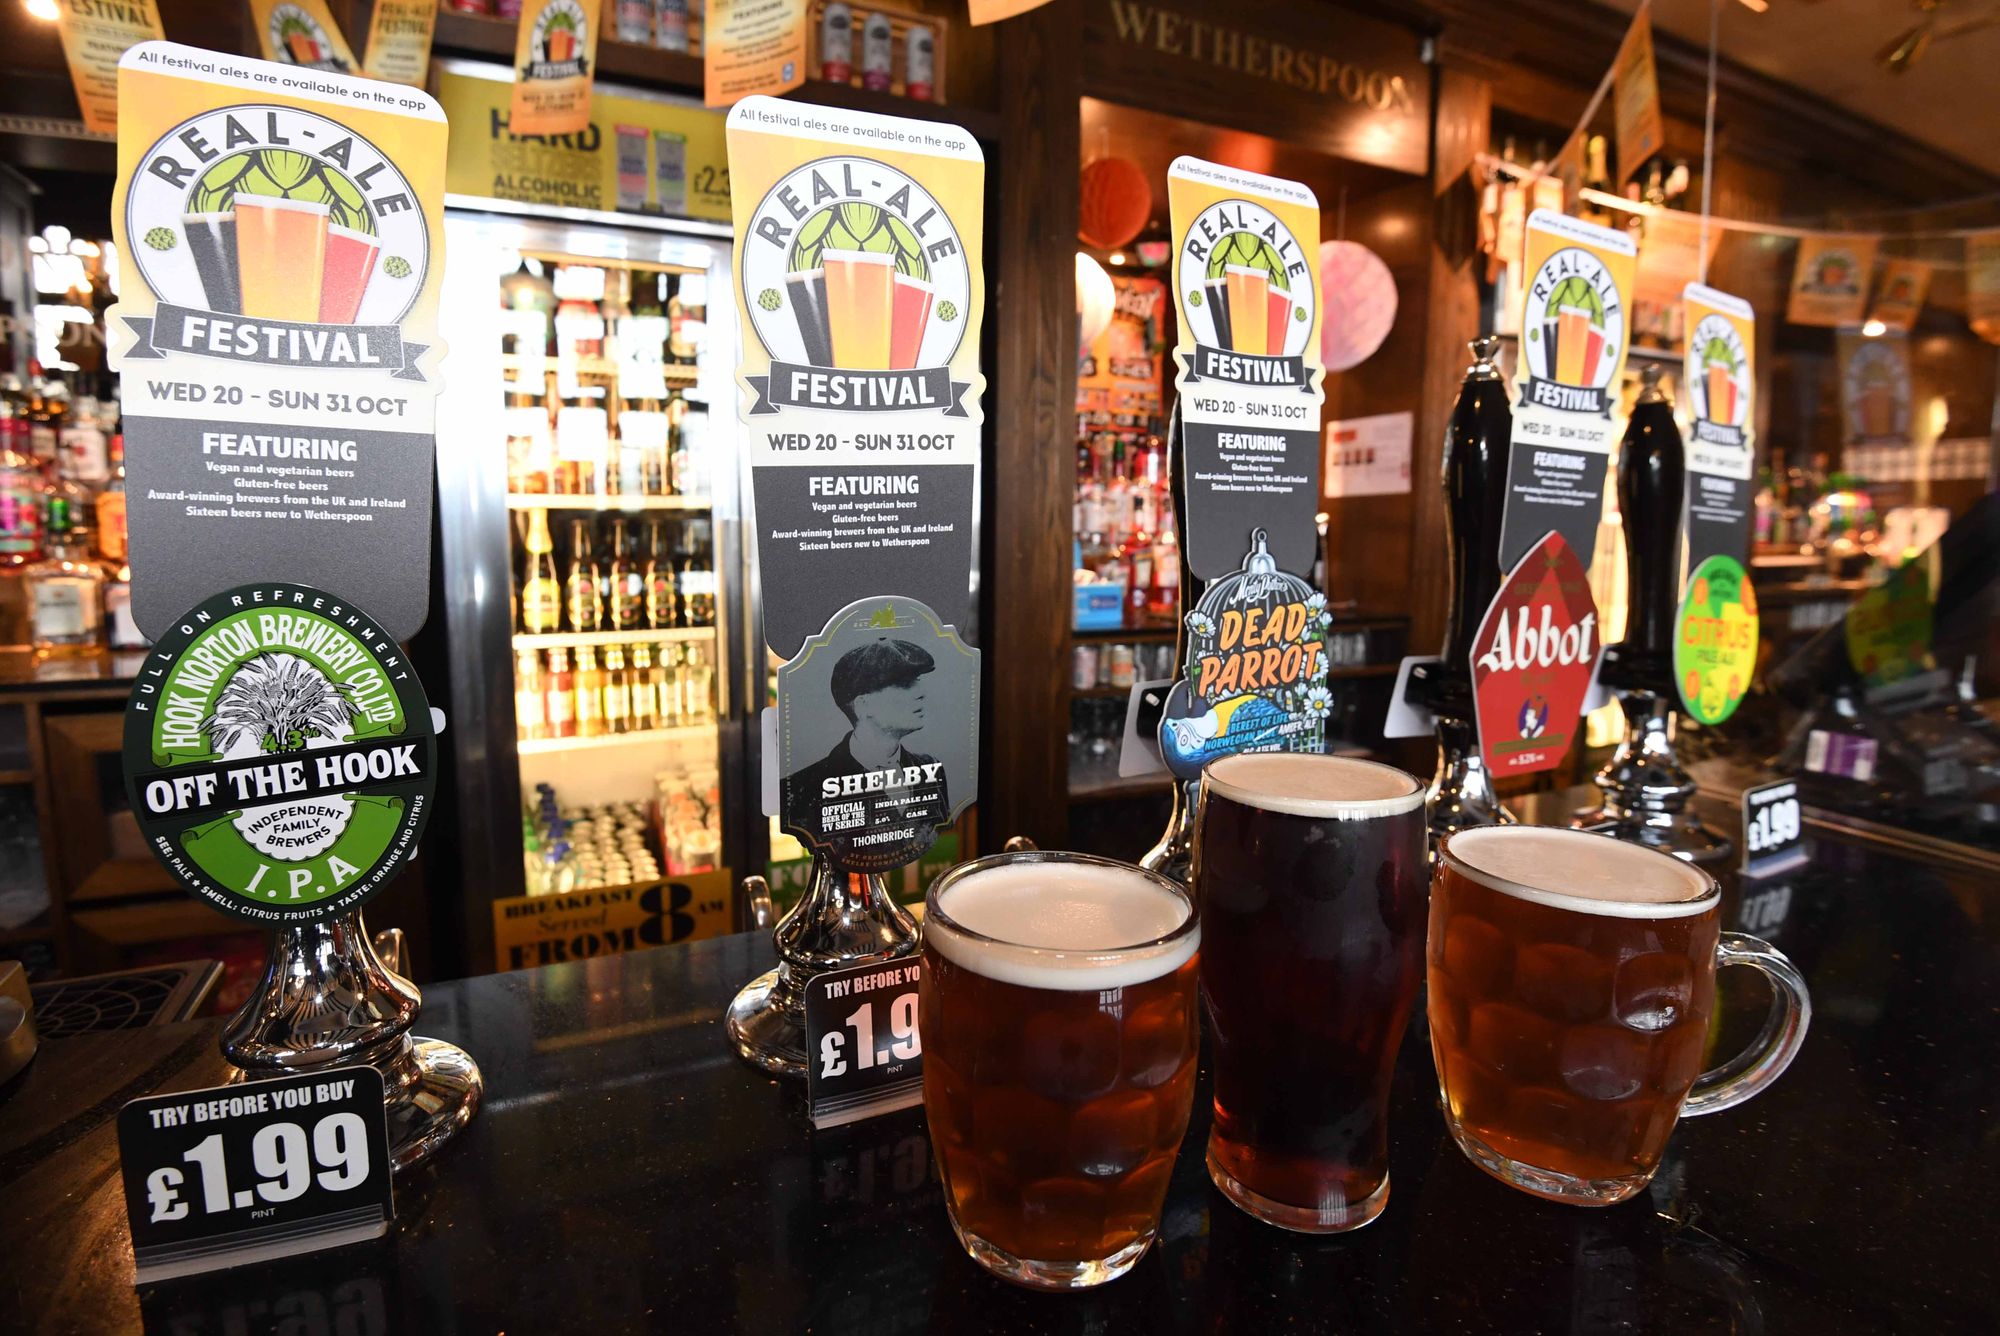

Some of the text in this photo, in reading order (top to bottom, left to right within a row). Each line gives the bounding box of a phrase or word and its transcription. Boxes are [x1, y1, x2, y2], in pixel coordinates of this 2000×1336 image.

[66, 0, 153, 28] ESTIVAL
[138, 50, 426, 112] All festival ales are available on the app
[490, 108, 601, 152] HD
[739, 108, 966, 152] All festival ales are available on the app
[147, 111, 413, 217] REAL-ALE
[494, 174, 602, 199] ALCOHOLIC
[755, 163, 957, 264] REAL-ALE
[1187, 205, 1305, 278] REAL-ALE
[182, 315, 380, 364] FESTIVAL
[1207, 352, 1296, 383] FESTIVAL
[147, 380, 408, 417] WED 20 SUN 31 OCT
[790, 371, 936, 407] FESTIVAL
[1533, 381, 1601, 412] FESTIVAL
[1193, 398, 1307, 419] WED 20 SUN 31 OCT
[202, 432, 358, 462] FEATURING
[767, 433, 955, 451] WED 20 SUN 31 OCT
[1217, 432, 1287, 452] FEATURING
[206, 461, 355, 479] Vegan and vegetarian beers
[233, 477, 329, 491] Gluten-free beers
[147, 489, 406, 509] Award-winning brewers from the UK and Ireland
[809, 475, 920, 497] FEATURING
[186, 505, 373, 523] Sixteen beers new to Wetherspoon
[812, 499, 918, 514] Vegan and vegetarian beers
[832, 513, 899, 524] Gluten-free beers
[771, 523, 954, 540] Award-winning brewers from the UK and Ireland
[799, 537, 930, 551] Sixteen beers new to Wetherspoon
[1219, 602, 1308, 651] DEAD
[1477, 604, 1596, 673] Abbot
[136, 590, 408, 712] FULL ON REFRESHMENT
[174, 619, 260, 695] NORTON
[258, 613, 369, 675] BREWERY
[1198, 640, 1324, 698] PARROT
[161, 690, 206, 749] HOOK
[1230, 719, 1261, 734] BEREFT
[1261, 716, 1272, 726] OF
[1272, 712, 1289, 723] LIFE
[1204, 731, 1256, 751] NORWEGIAN
[145, 744, 421, 814] OFF THE HOOK
[822, 763, 943, 799] SHELBY
[821, 801, 865, 817] OFFICIAL
[874, 799, 900, 809] INDIA
[900, 796, 921, 805] PALE
[921, 793, 938, 802] ALE
[906, 809, 929, 819] CASK
[247, 804, 345, 835] INDEPENDENT
[273, 817, 321, 835] FAMILY
[821, 811, 865, 824] BEER OF THE
[821, 823, 834, 833] TV
[835, 817, 866, 831] SERIES
[265, 825, 332, 848] BREWERS
[852, 827, 915, 848] THORNBRIDGE
[171, 857, 193, 881] PALE
[199, 885, 240, 912] SMELL:
[240, 906, 281, 921] CITRUS
[283, 907, 325, 921] FRUITS
[337, 882, 374, 907] TASTE:
[371, 848, 404, 884] ORANGE
[401, 829, 413, 850] AND
[407, 794, 425, 828] CITRUS
[505, 888, 634, 919] BREAKFAST
[639, 882, 696, 945] 8
[509, 927, 638, 970] FROM
[824, 965, 921, 1000] TRY BEFORE YO
[820, 992, 922, 1080] £1.9
[886, 1064, 904, 1075] PINT
[149, 1079, 355, 1129] TRY BEFORE YOU BUY
[146, 1112, 370, 1224] £1.99
[250, 1207, 277, 1220] PINT
